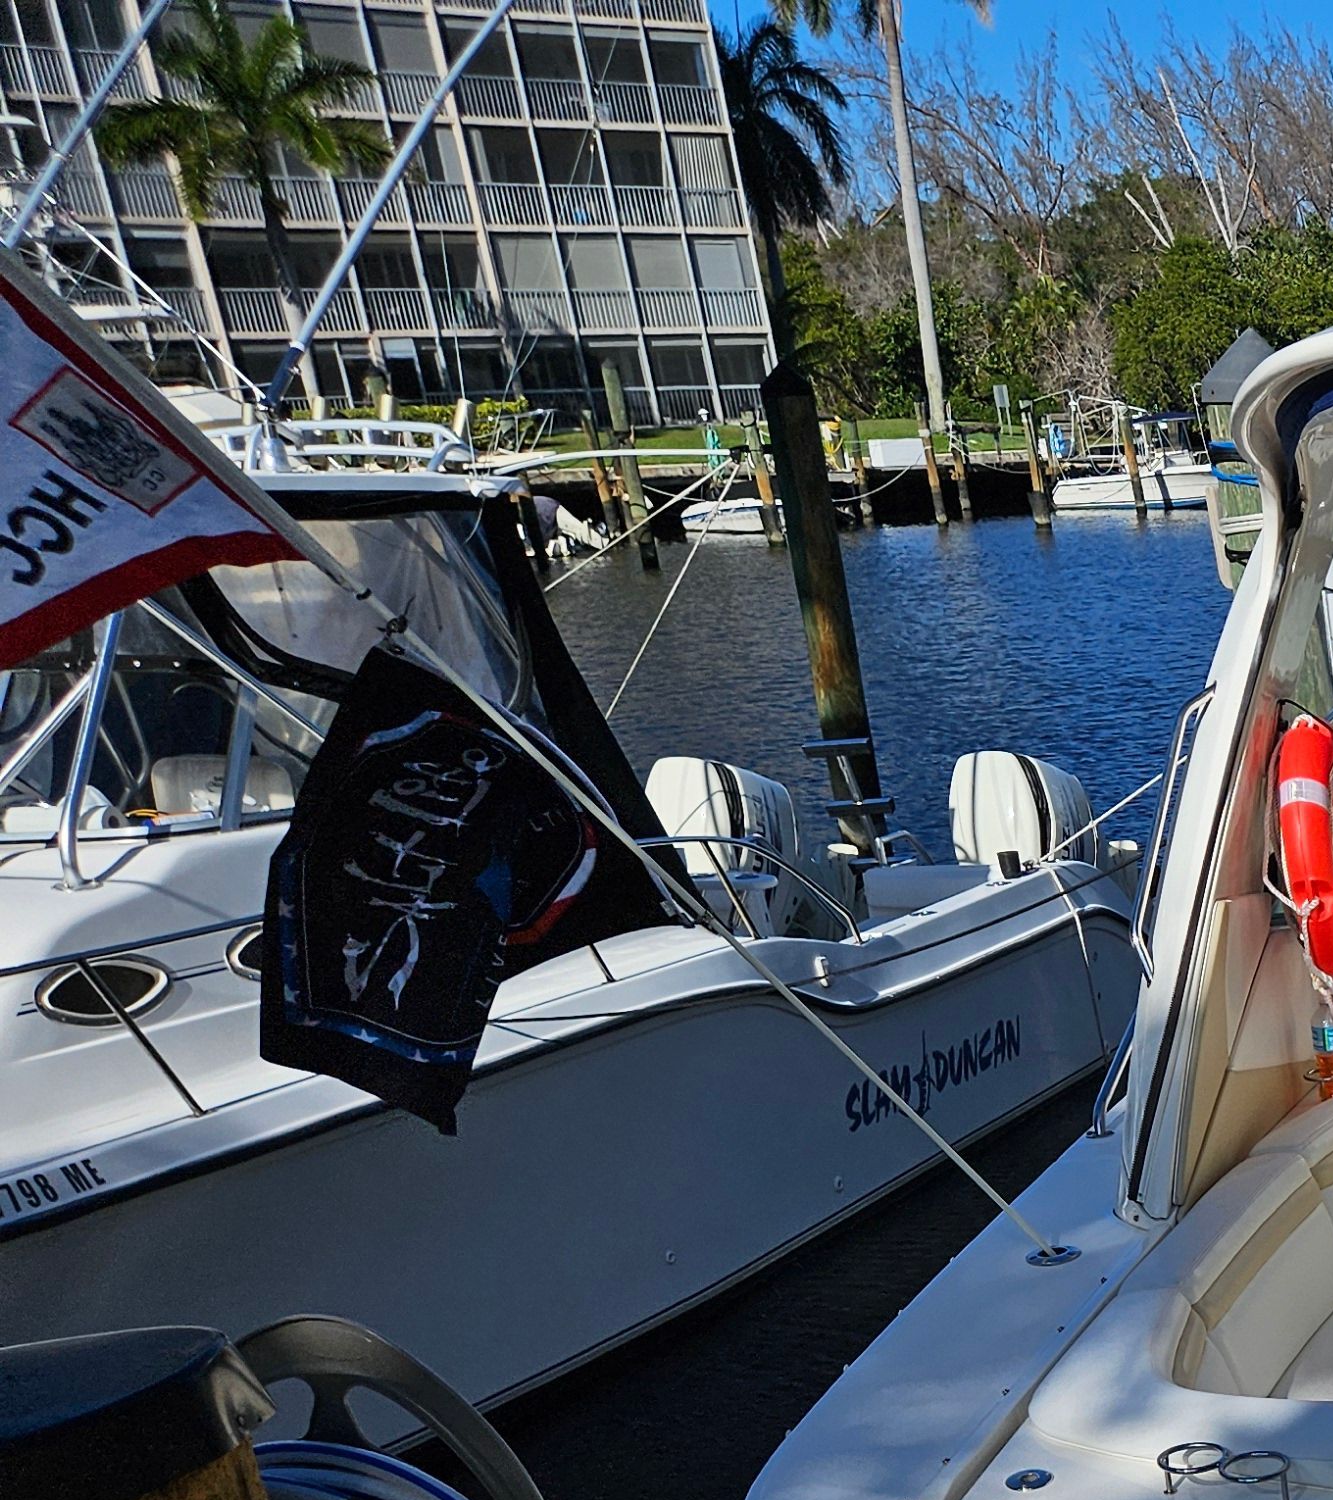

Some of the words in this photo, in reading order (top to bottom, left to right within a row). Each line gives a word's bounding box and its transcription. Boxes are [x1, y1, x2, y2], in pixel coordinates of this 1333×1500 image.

[846, 1065, 911, 1132] SLAM
[933, 1015, 1020, 1093] DUNCAN
[0, 1173, 59, 1218] 798
[59, 1158, 107, 1193] ME
